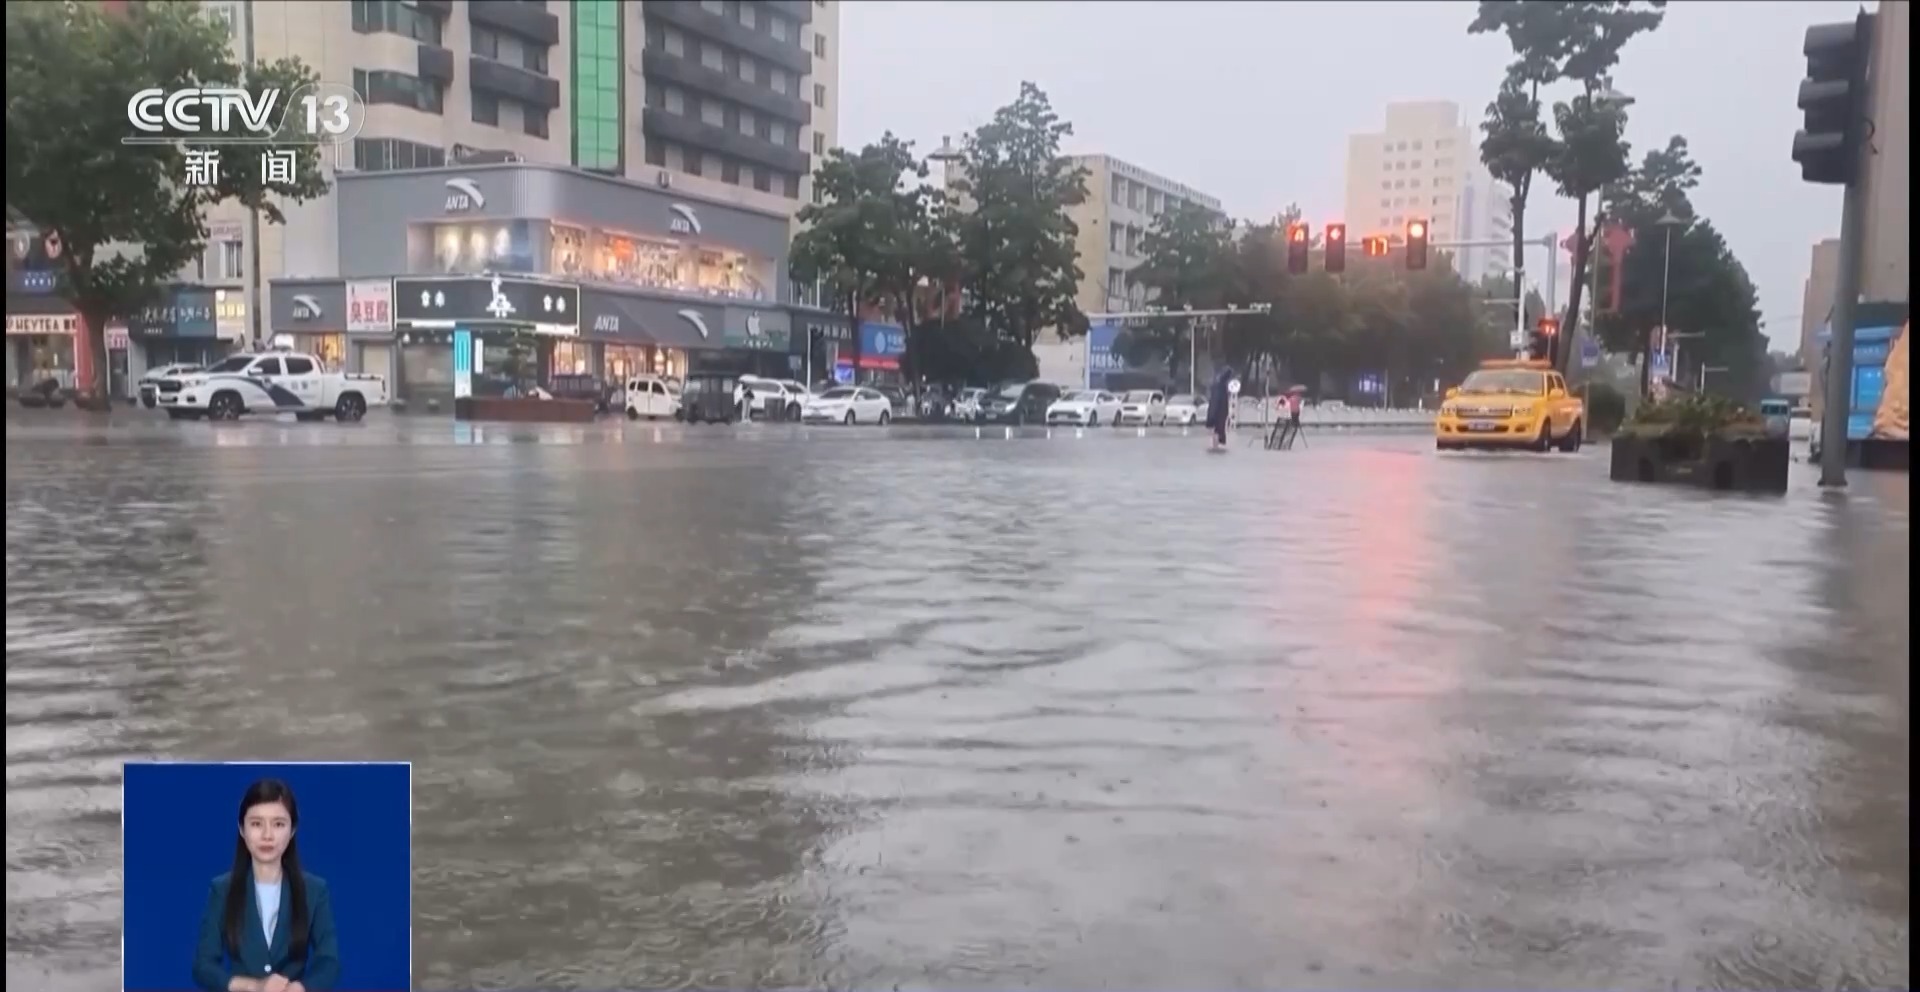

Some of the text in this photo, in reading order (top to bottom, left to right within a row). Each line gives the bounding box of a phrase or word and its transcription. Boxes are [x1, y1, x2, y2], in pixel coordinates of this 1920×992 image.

[444, 194, 469, 210] ANTA
[670, 217, 690, 233] ANTA
[350, 300, 388, 324] 臭豆腐
[15, 318, 59, 330] HEYTEA
[594, 315, 619, 333] ANTA
